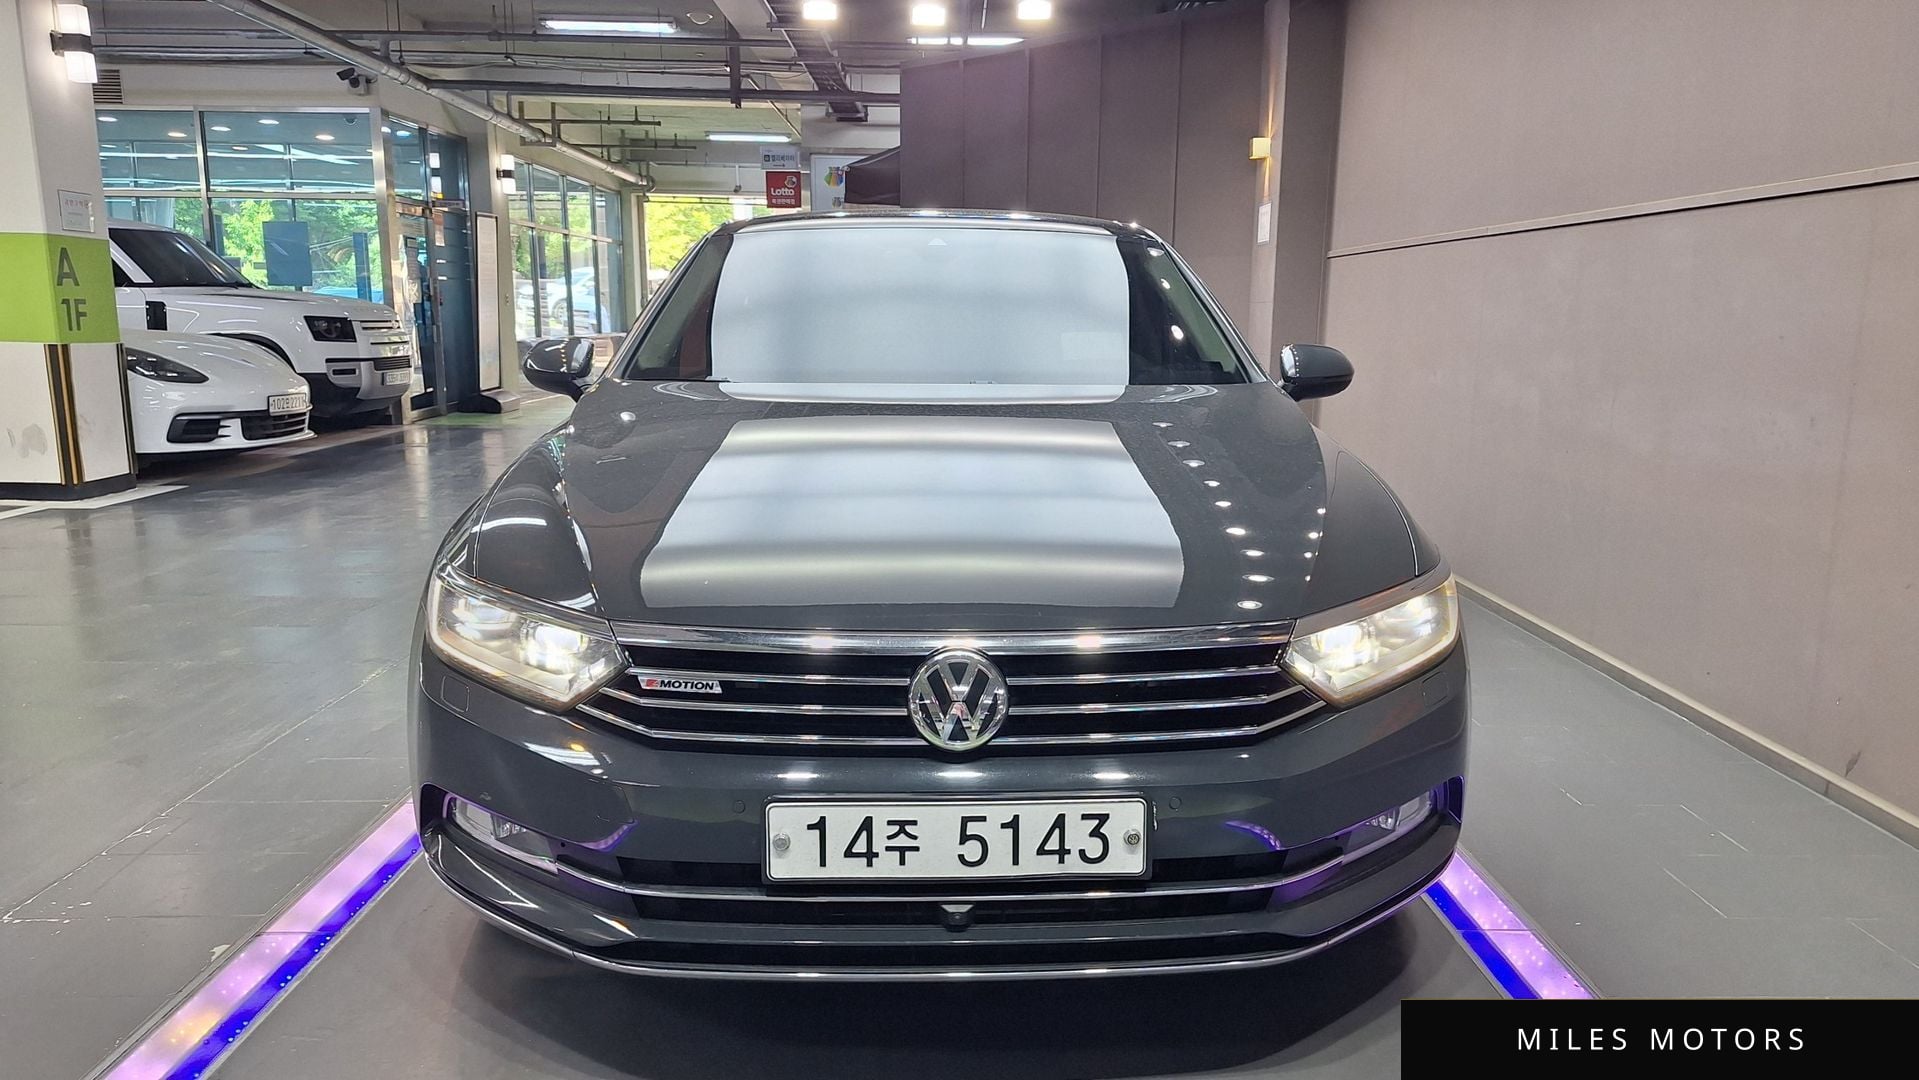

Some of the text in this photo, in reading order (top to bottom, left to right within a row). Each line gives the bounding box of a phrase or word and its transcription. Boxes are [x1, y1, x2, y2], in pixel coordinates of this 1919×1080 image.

[771, 187, 795, 196] Lotto
[56, 247, 80, 287] A
[61, 299, 88, 331] 1F
[806, 812, 1111, 868] 14주 5143
